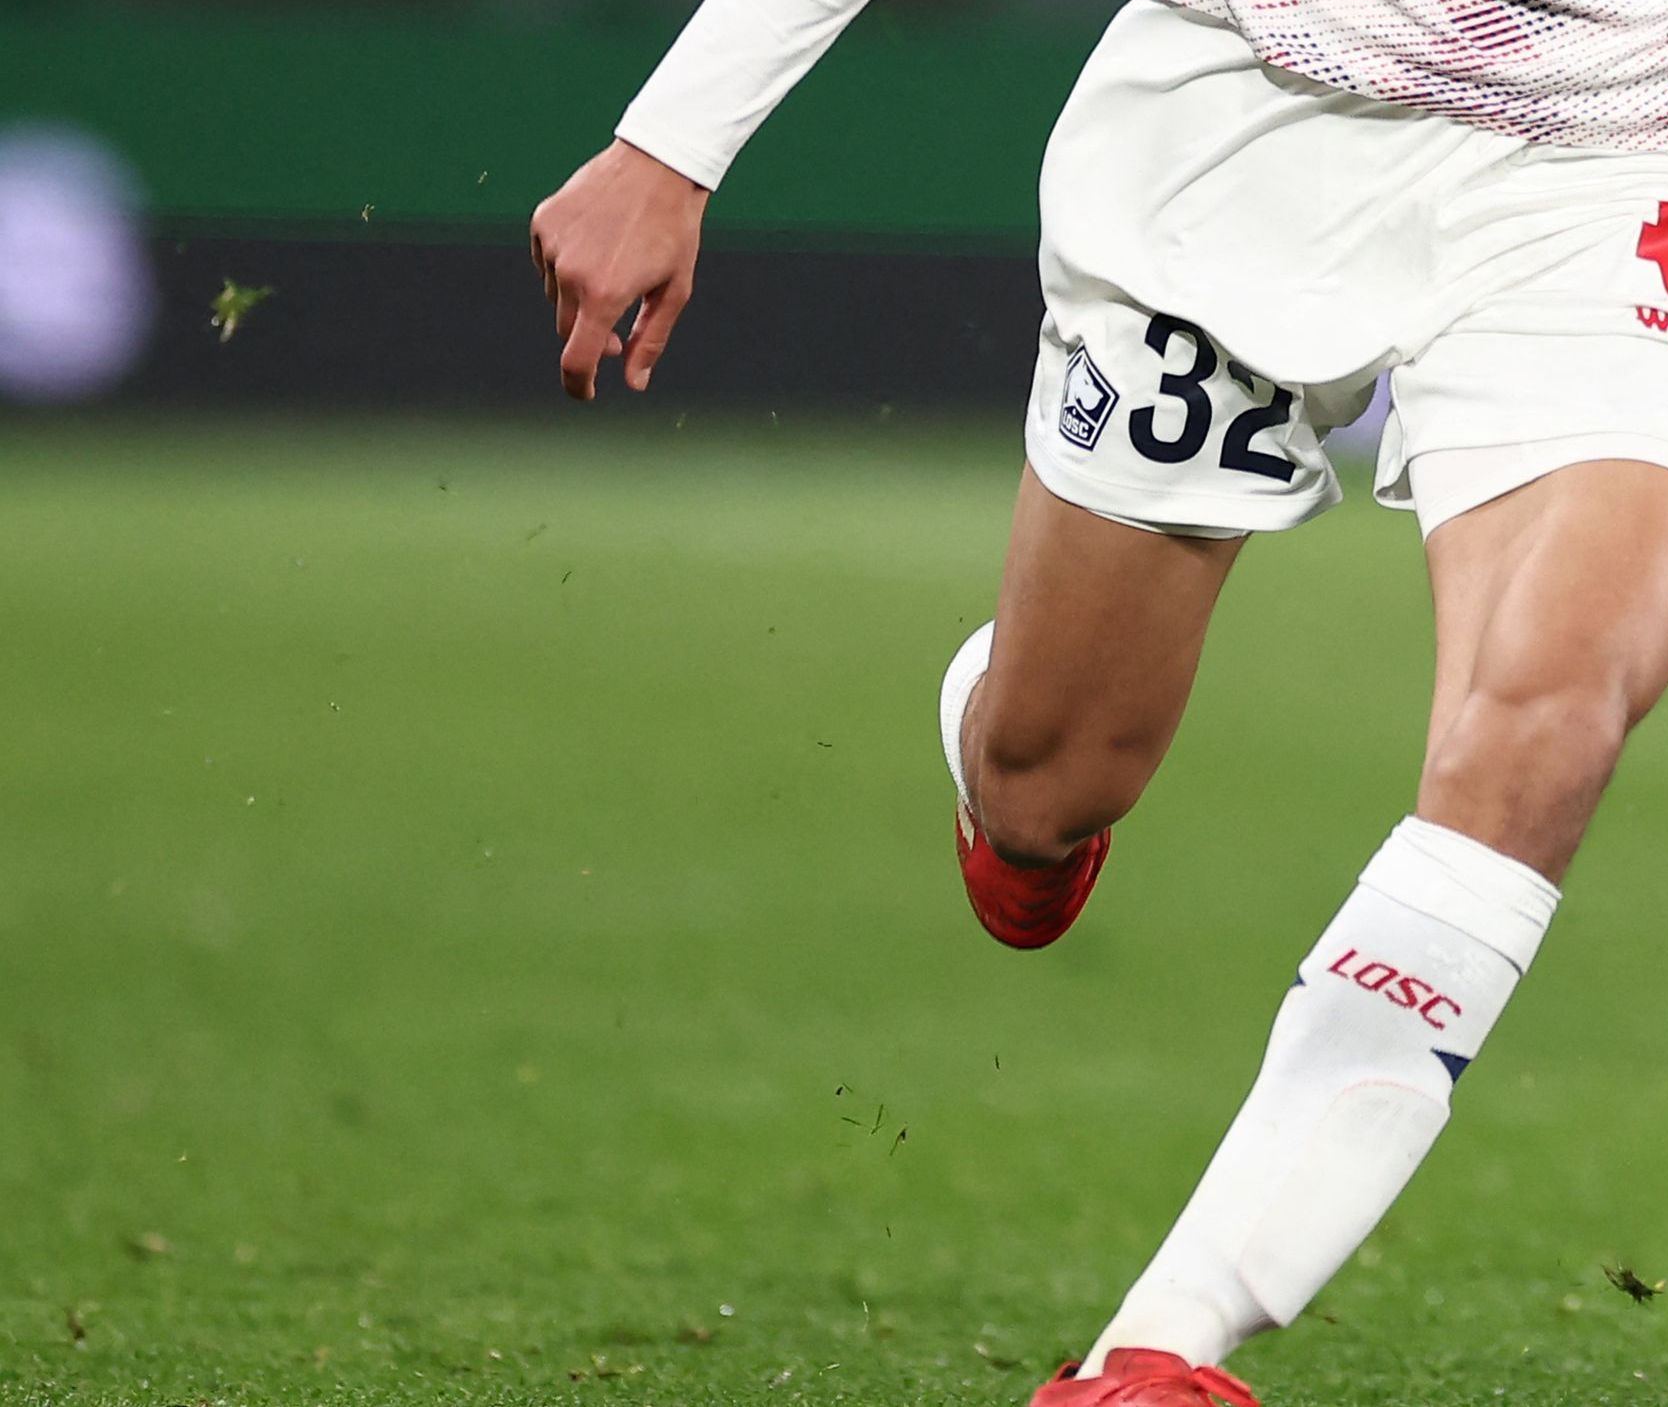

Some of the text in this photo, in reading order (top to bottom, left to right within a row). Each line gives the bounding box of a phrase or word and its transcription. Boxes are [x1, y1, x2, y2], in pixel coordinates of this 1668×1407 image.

[1062, 409, 1090, 438] LOSC
[1128, 312, 1297, 483] 32
[1327, 948, 1462, 1031] LOSC
